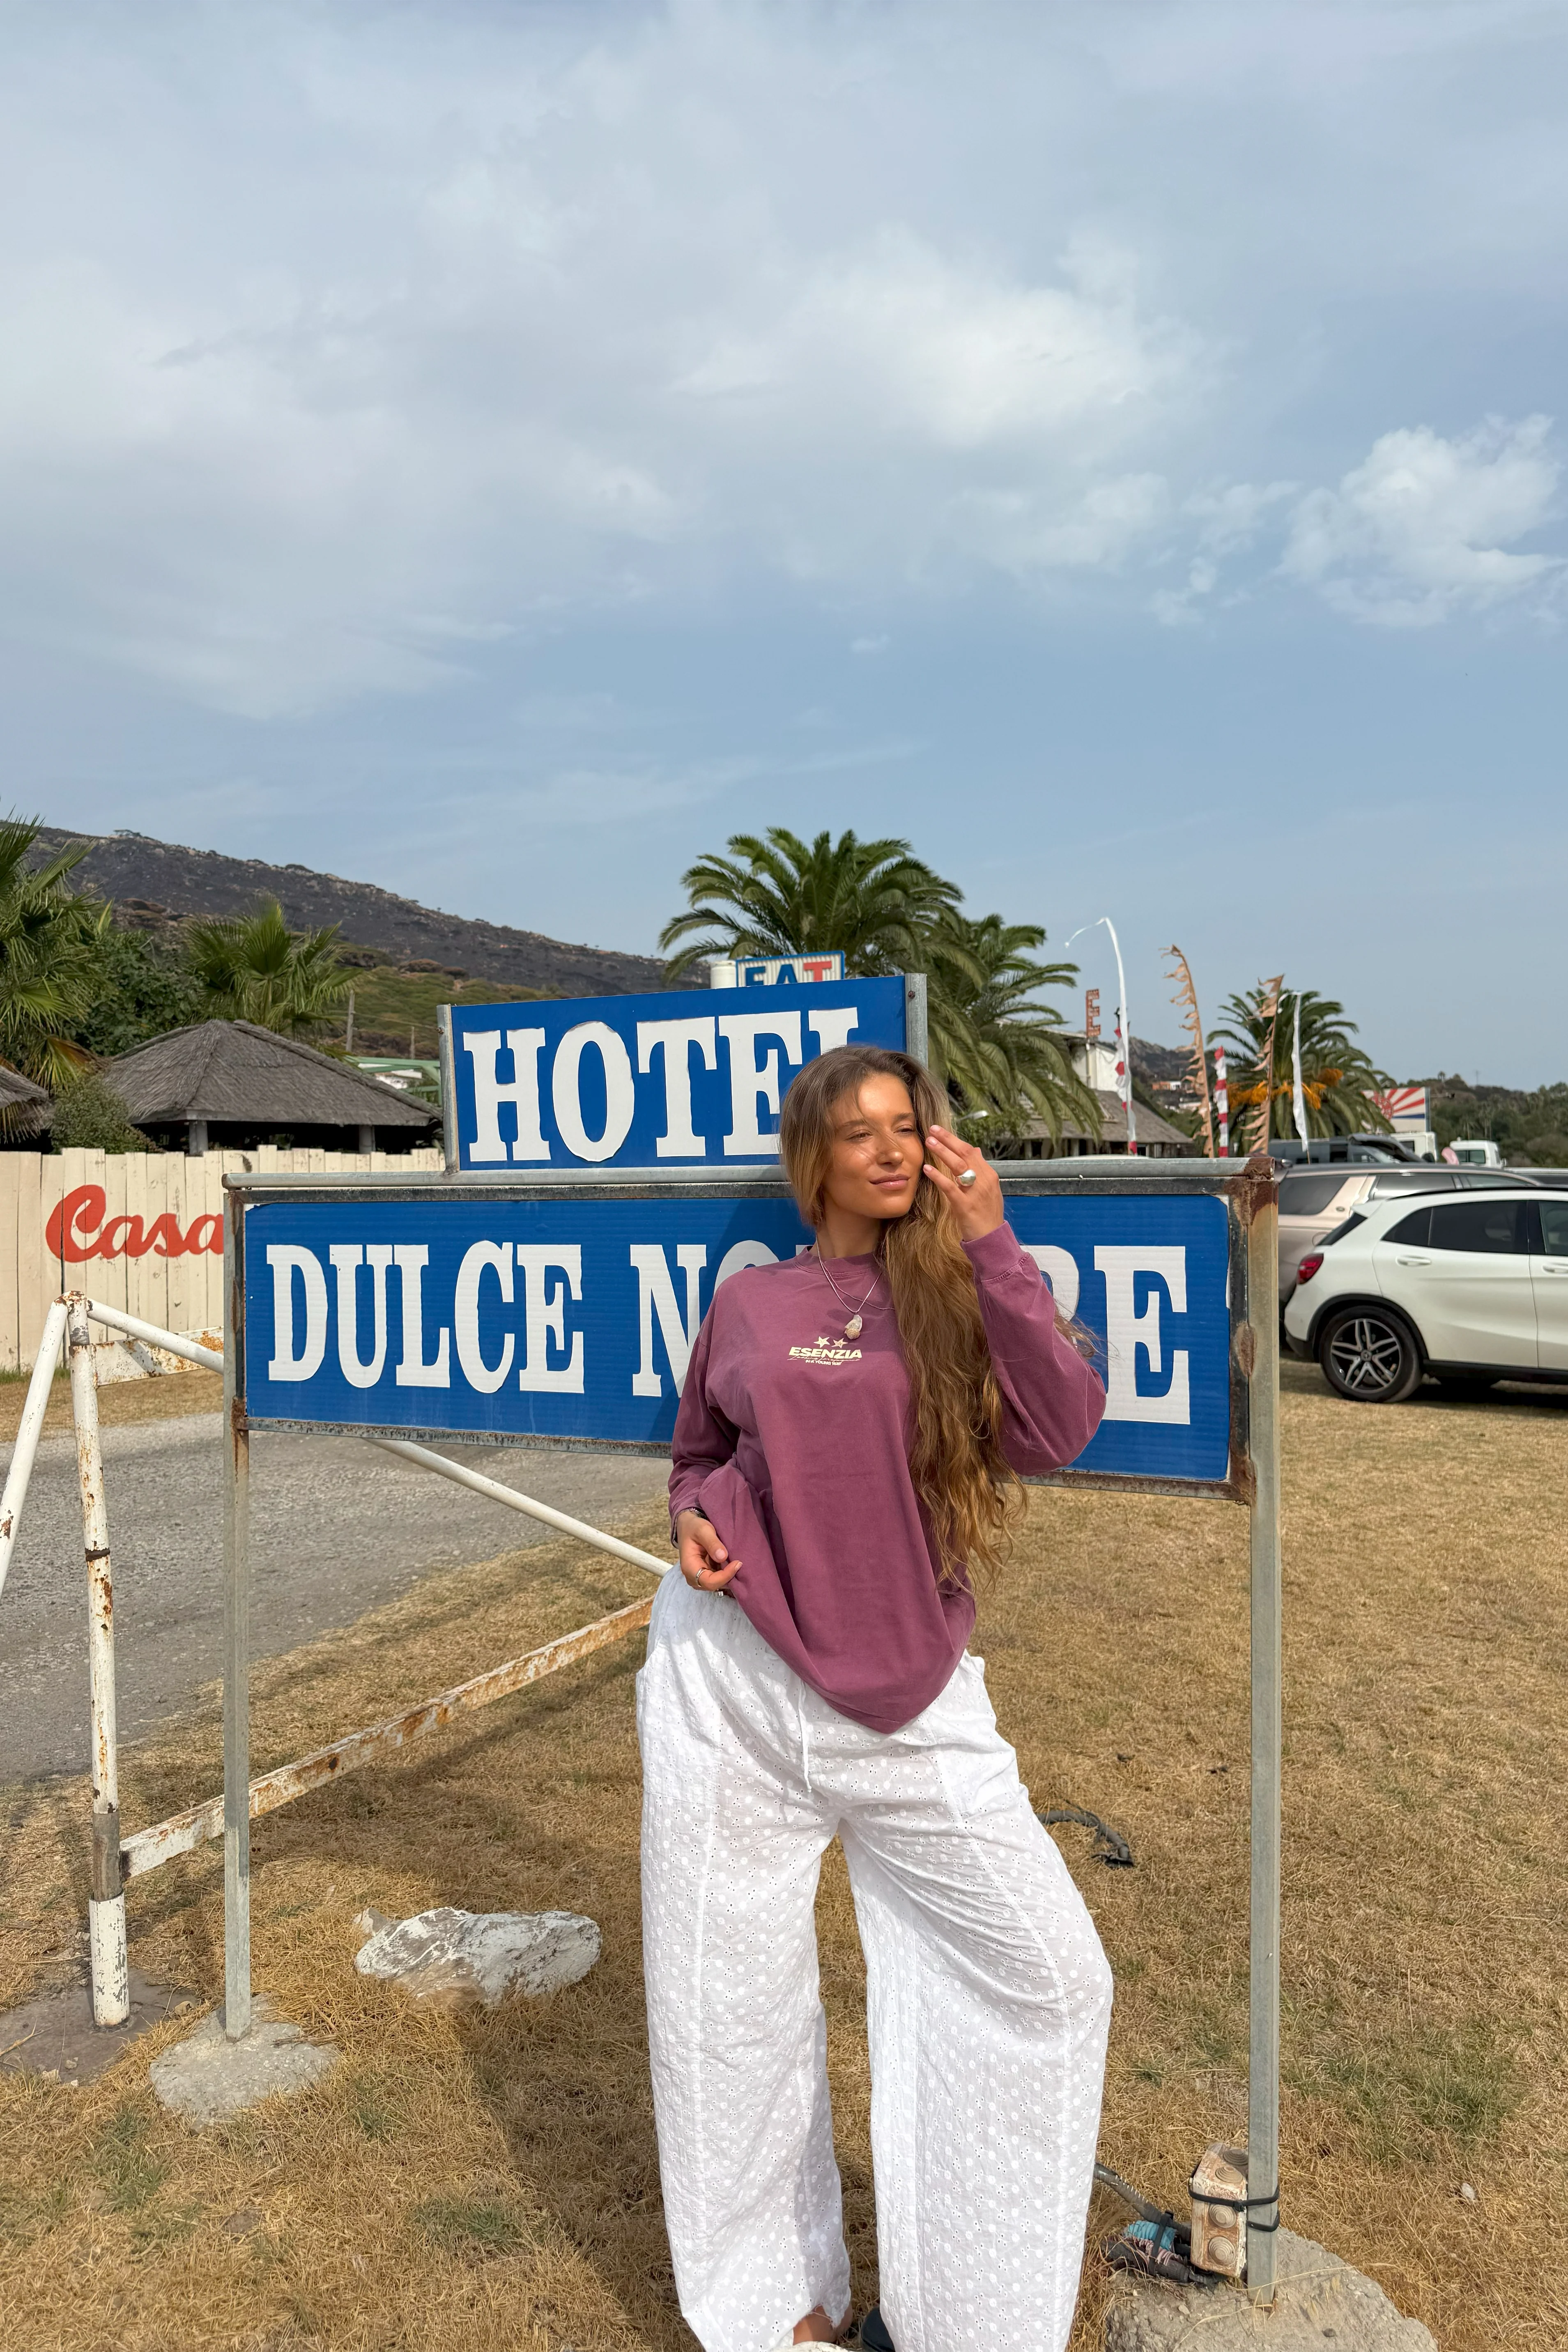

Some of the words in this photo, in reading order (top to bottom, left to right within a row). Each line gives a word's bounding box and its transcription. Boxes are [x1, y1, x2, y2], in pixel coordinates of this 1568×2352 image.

[45, 1184, 224, 1263] Casa
[267, 1240, 584, 1393] DULCE
[789, 1347, 862, 1359] ESENZIA
